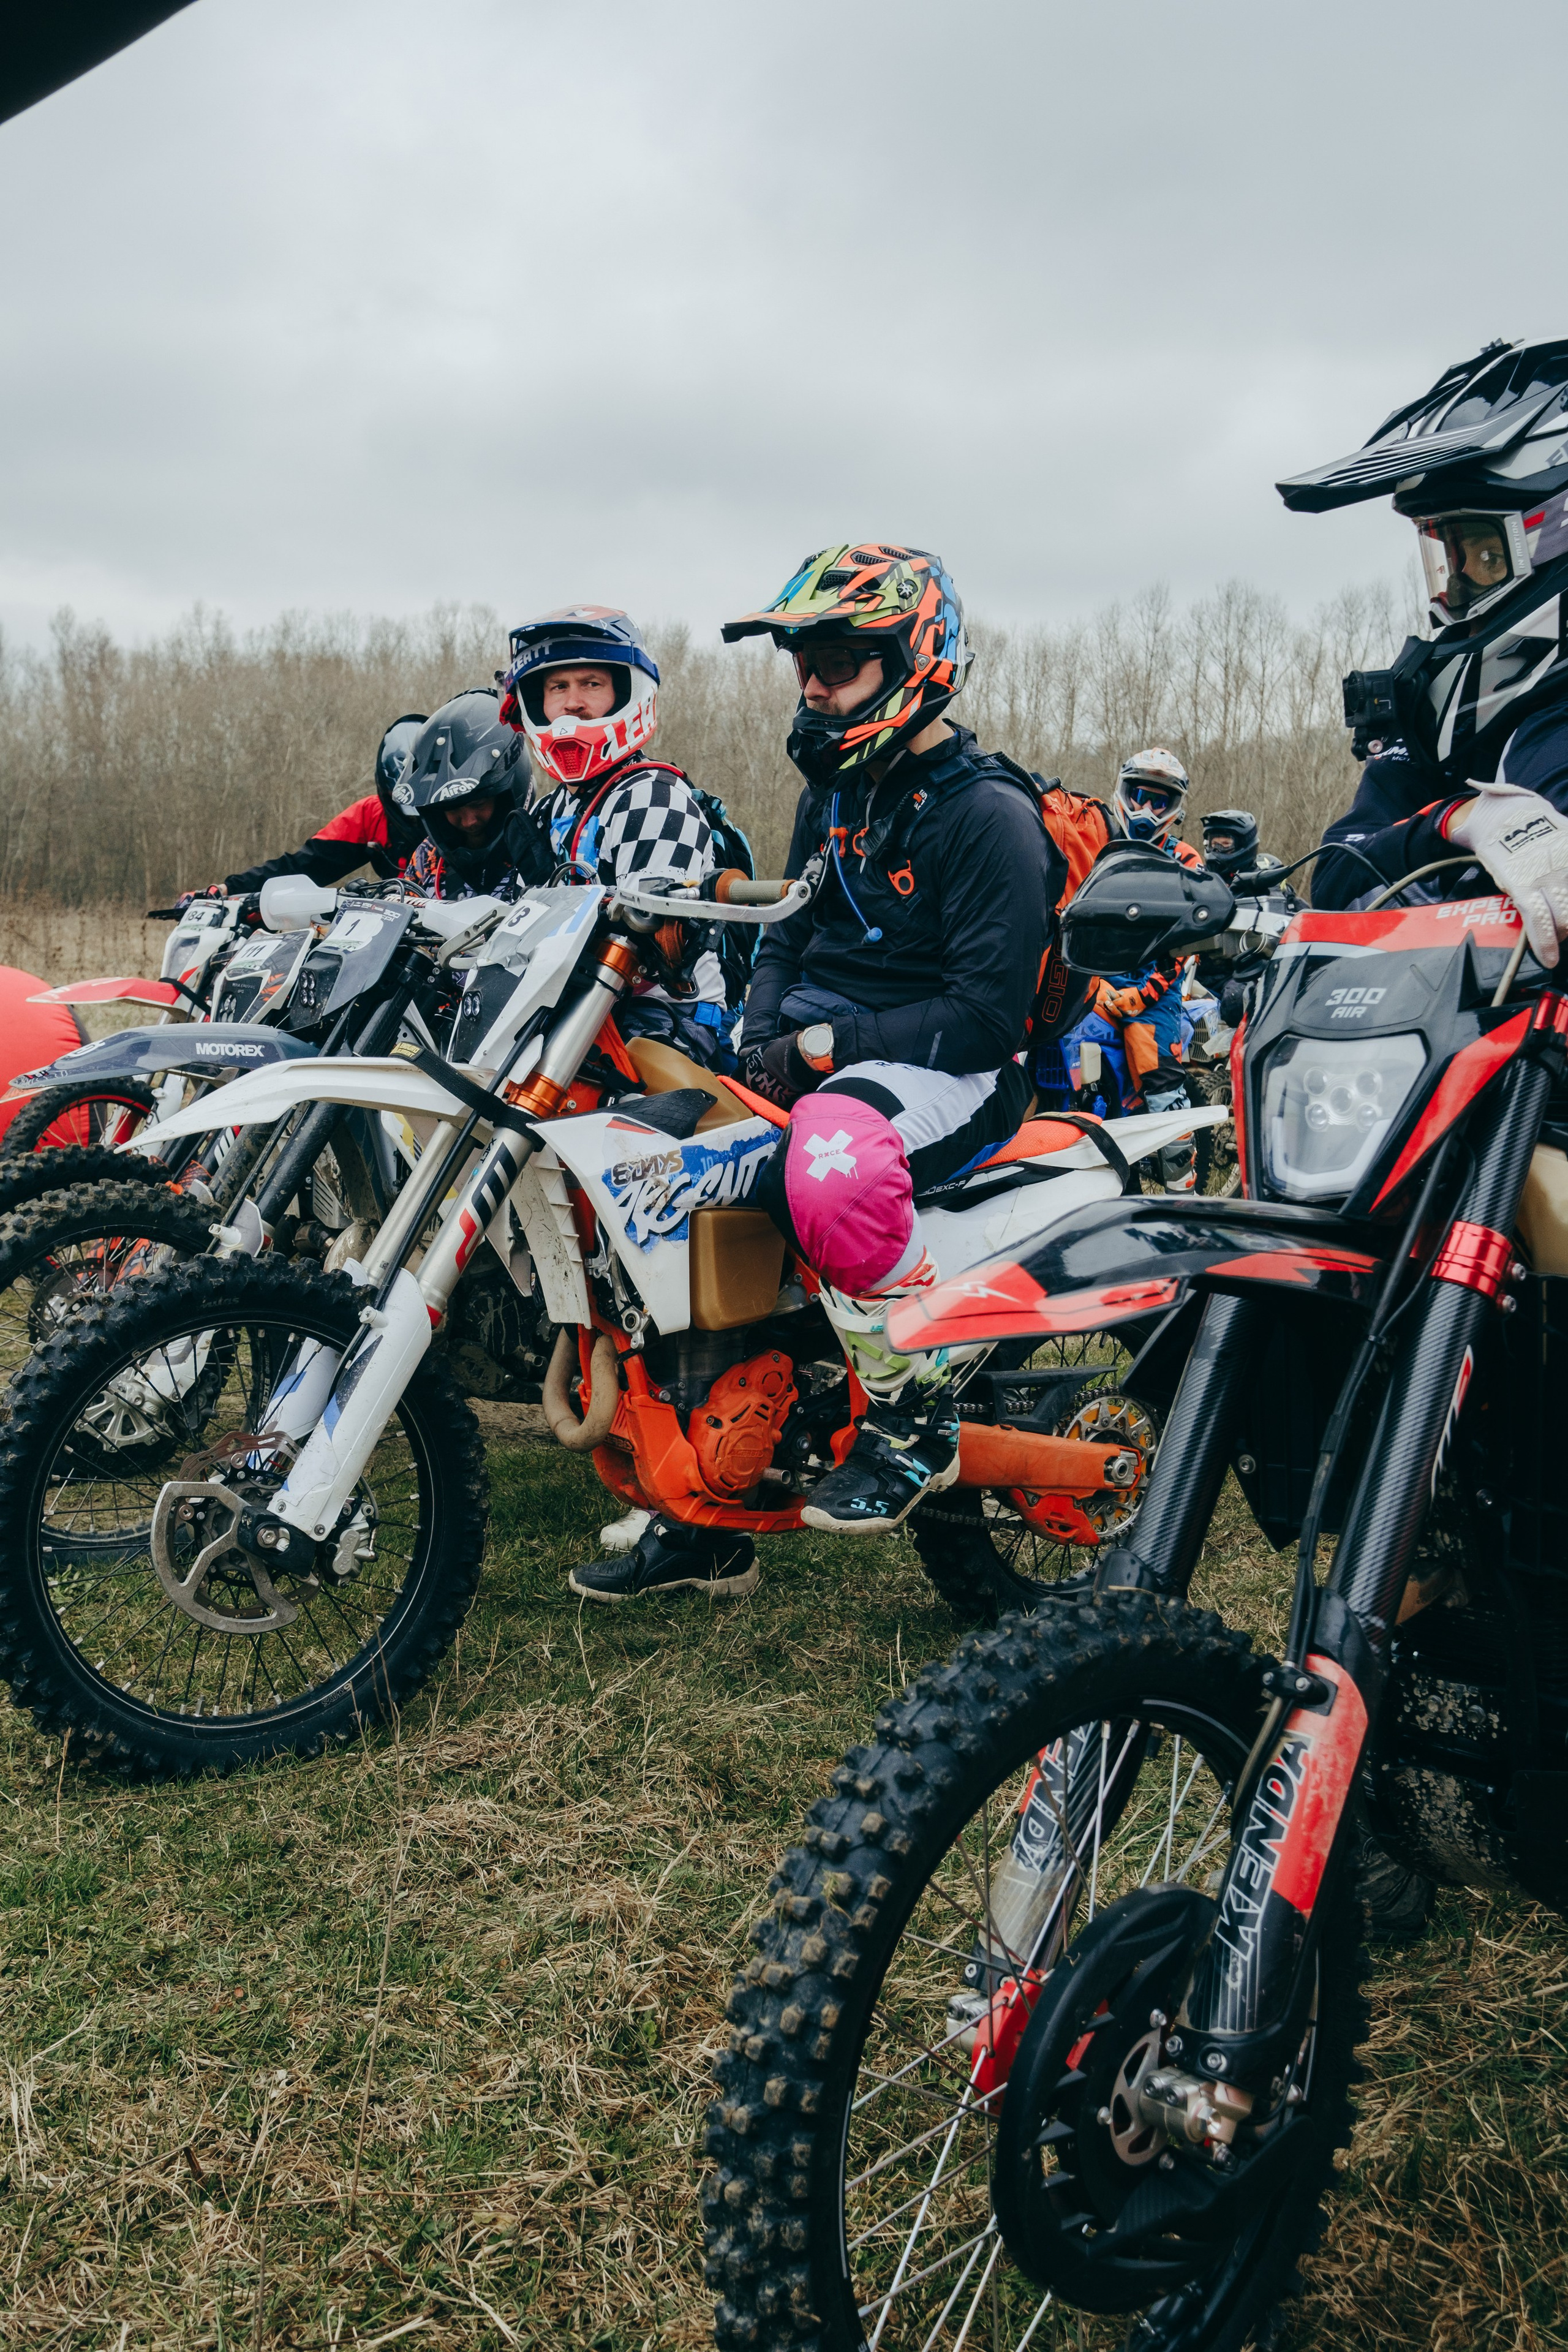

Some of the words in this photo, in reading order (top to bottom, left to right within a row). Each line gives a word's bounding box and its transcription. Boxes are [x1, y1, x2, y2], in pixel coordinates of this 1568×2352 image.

[512, 641, 552, 676] LEATT
[185, 911, 206, 921] 184
[505, 905, 530, 927] 13
[1462, 910, 1517, 927] PRO
[345, 919, 361, 937] 1
[241, 945, 266, 958] 111
[1325, 987, 1387, 1006] 300
[1330, 1006, 1367, 1018] AIR
[196, 1042, 264, 1057] MOTOREX
[480, 1137, 497, 1164] XACT
[850, 1497, 889, 1515] 5.5
[1215, 1729, 1314, 1961] KENDA
